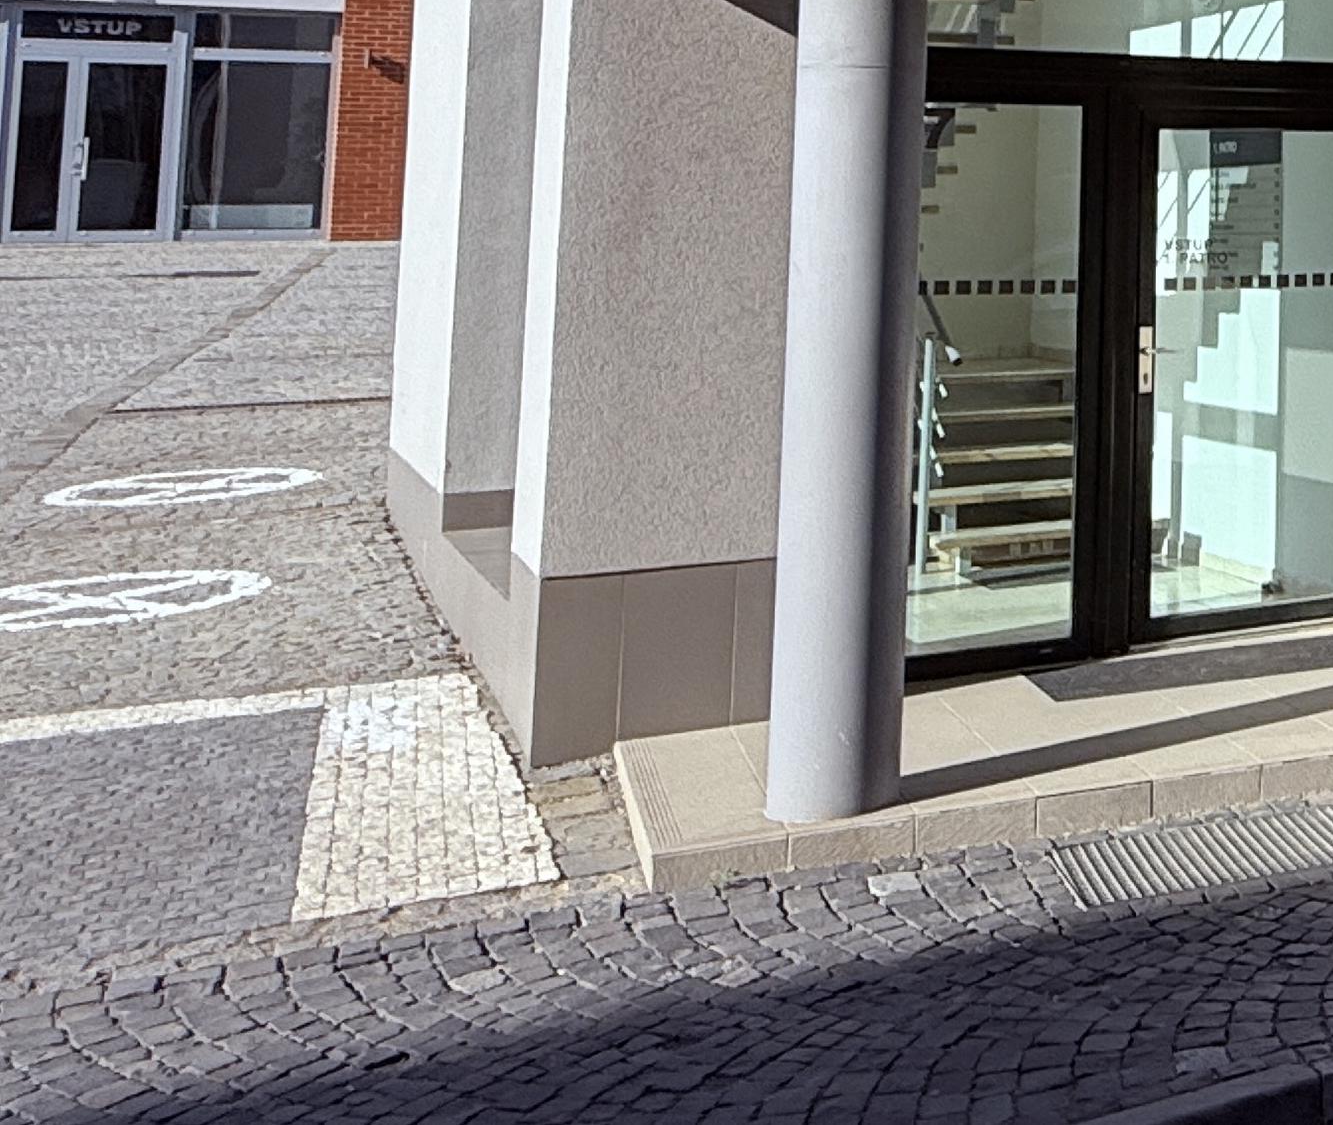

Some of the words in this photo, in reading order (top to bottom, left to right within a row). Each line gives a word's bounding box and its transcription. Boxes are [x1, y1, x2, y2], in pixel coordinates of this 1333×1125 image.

[57, 17, 143, 36] VSTUP
[1165, 238, 1213, 251] VSTUP
[1180, 252, 1228, 264] PATRO
